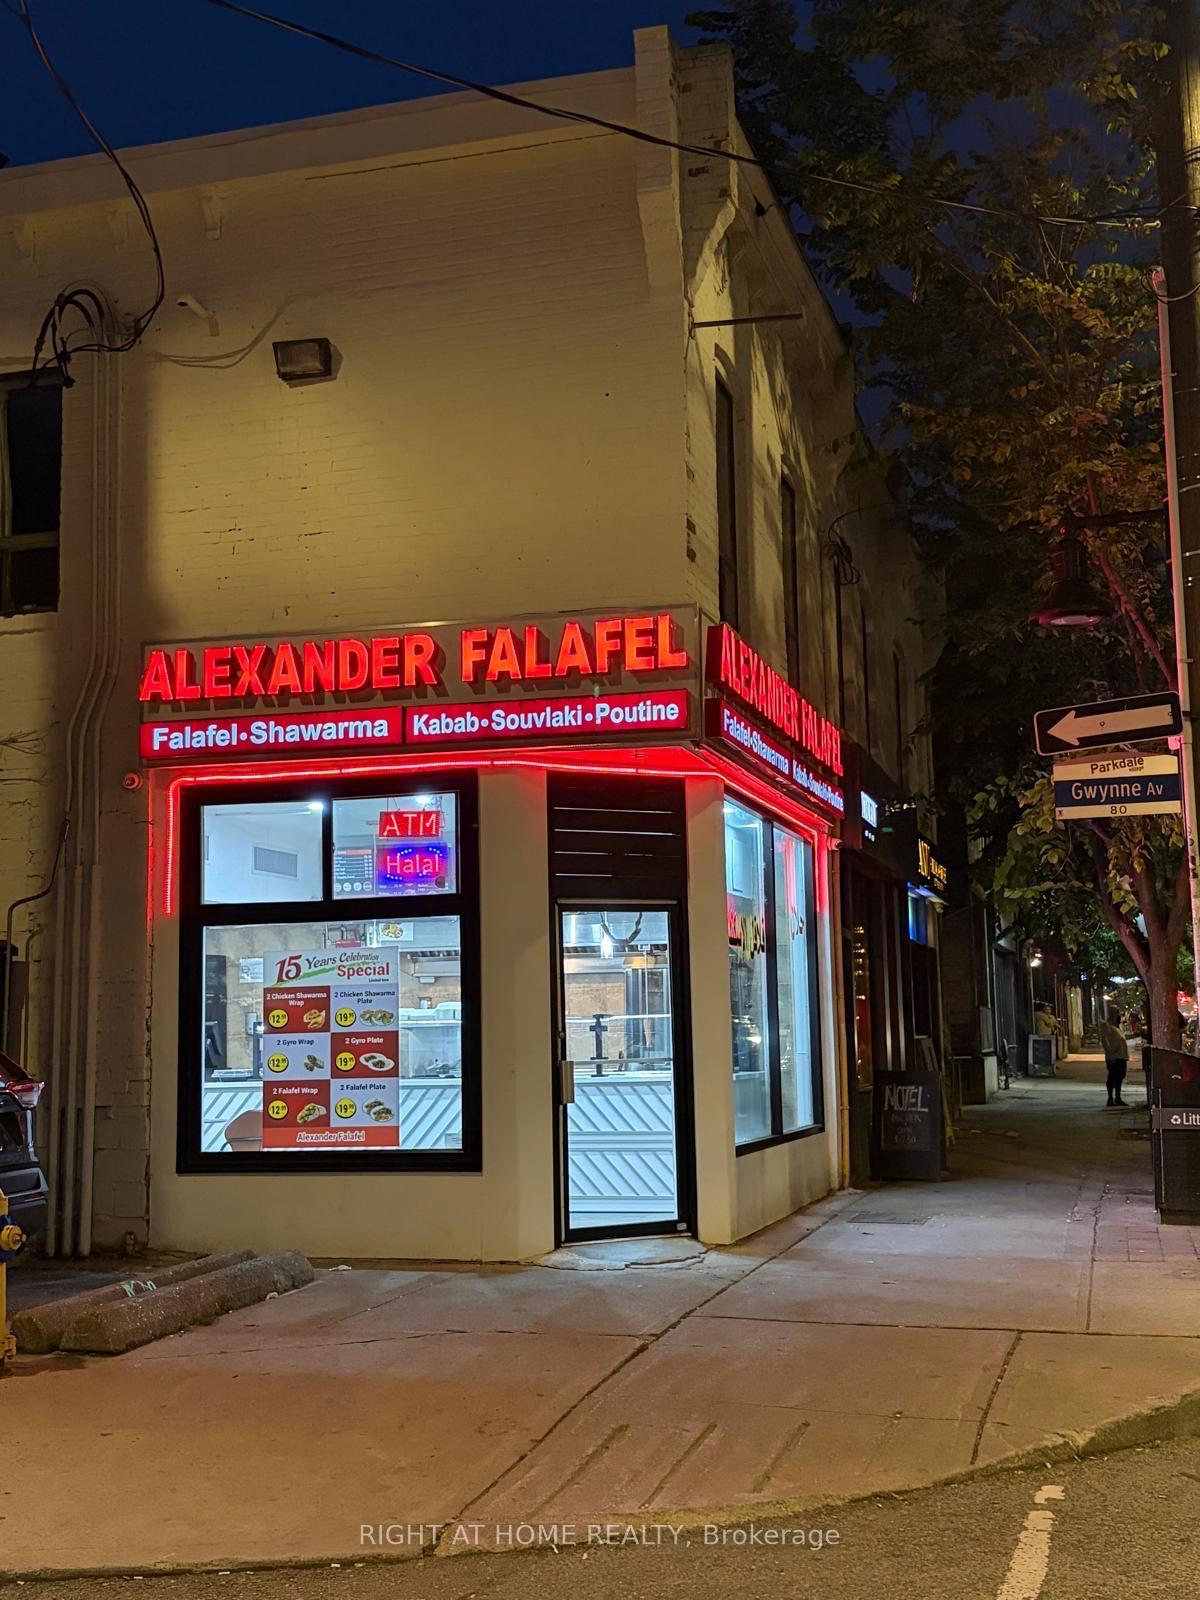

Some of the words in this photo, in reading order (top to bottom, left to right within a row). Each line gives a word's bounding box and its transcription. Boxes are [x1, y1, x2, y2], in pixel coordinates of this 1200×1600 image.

[138, 633, 438, 701] ALEXANDER
[461, 614, 687, 683] FALAFEL
[720, 624, 799, 742] ALEXANDER
[801, 698, 843, 777] FALAFEL
[152, 723, 238, 750] Falafel
[250, 718, 389, 745] Shawarma
[413, 711, 480, 736] Kabab
[491, 705, 582, 731] Souvlaki
[595, 701, 679, 725] Poutine
[723, 709, 751, 748] Falafel
[752, 731, 789, 775] Shawarma
[1090, 757, 1144, 774] Parkdale
[1071, 782, 1141, 803] Gwynne
[1146, 782, 1163, 796] Av
[1110, 805, 1127, 815] 80
[383, 813, 437, 836] ATM
[386, 854, 439, 874] Halal
[275, 954, 303, 984] 15
[305, 955, 337, 969] Years
[339, 952, 379, 963] Celebration
[337, 962, 390, 980] Special
[282, 1039, 297, 1047] Gyro
[351, 1037, 366, 1045] Gyro
[301, 1087, 319, 1095] Wrap
[296, 1131, 336, 1142] Alexander
[337, 1130, 366, 1141] Falafel
